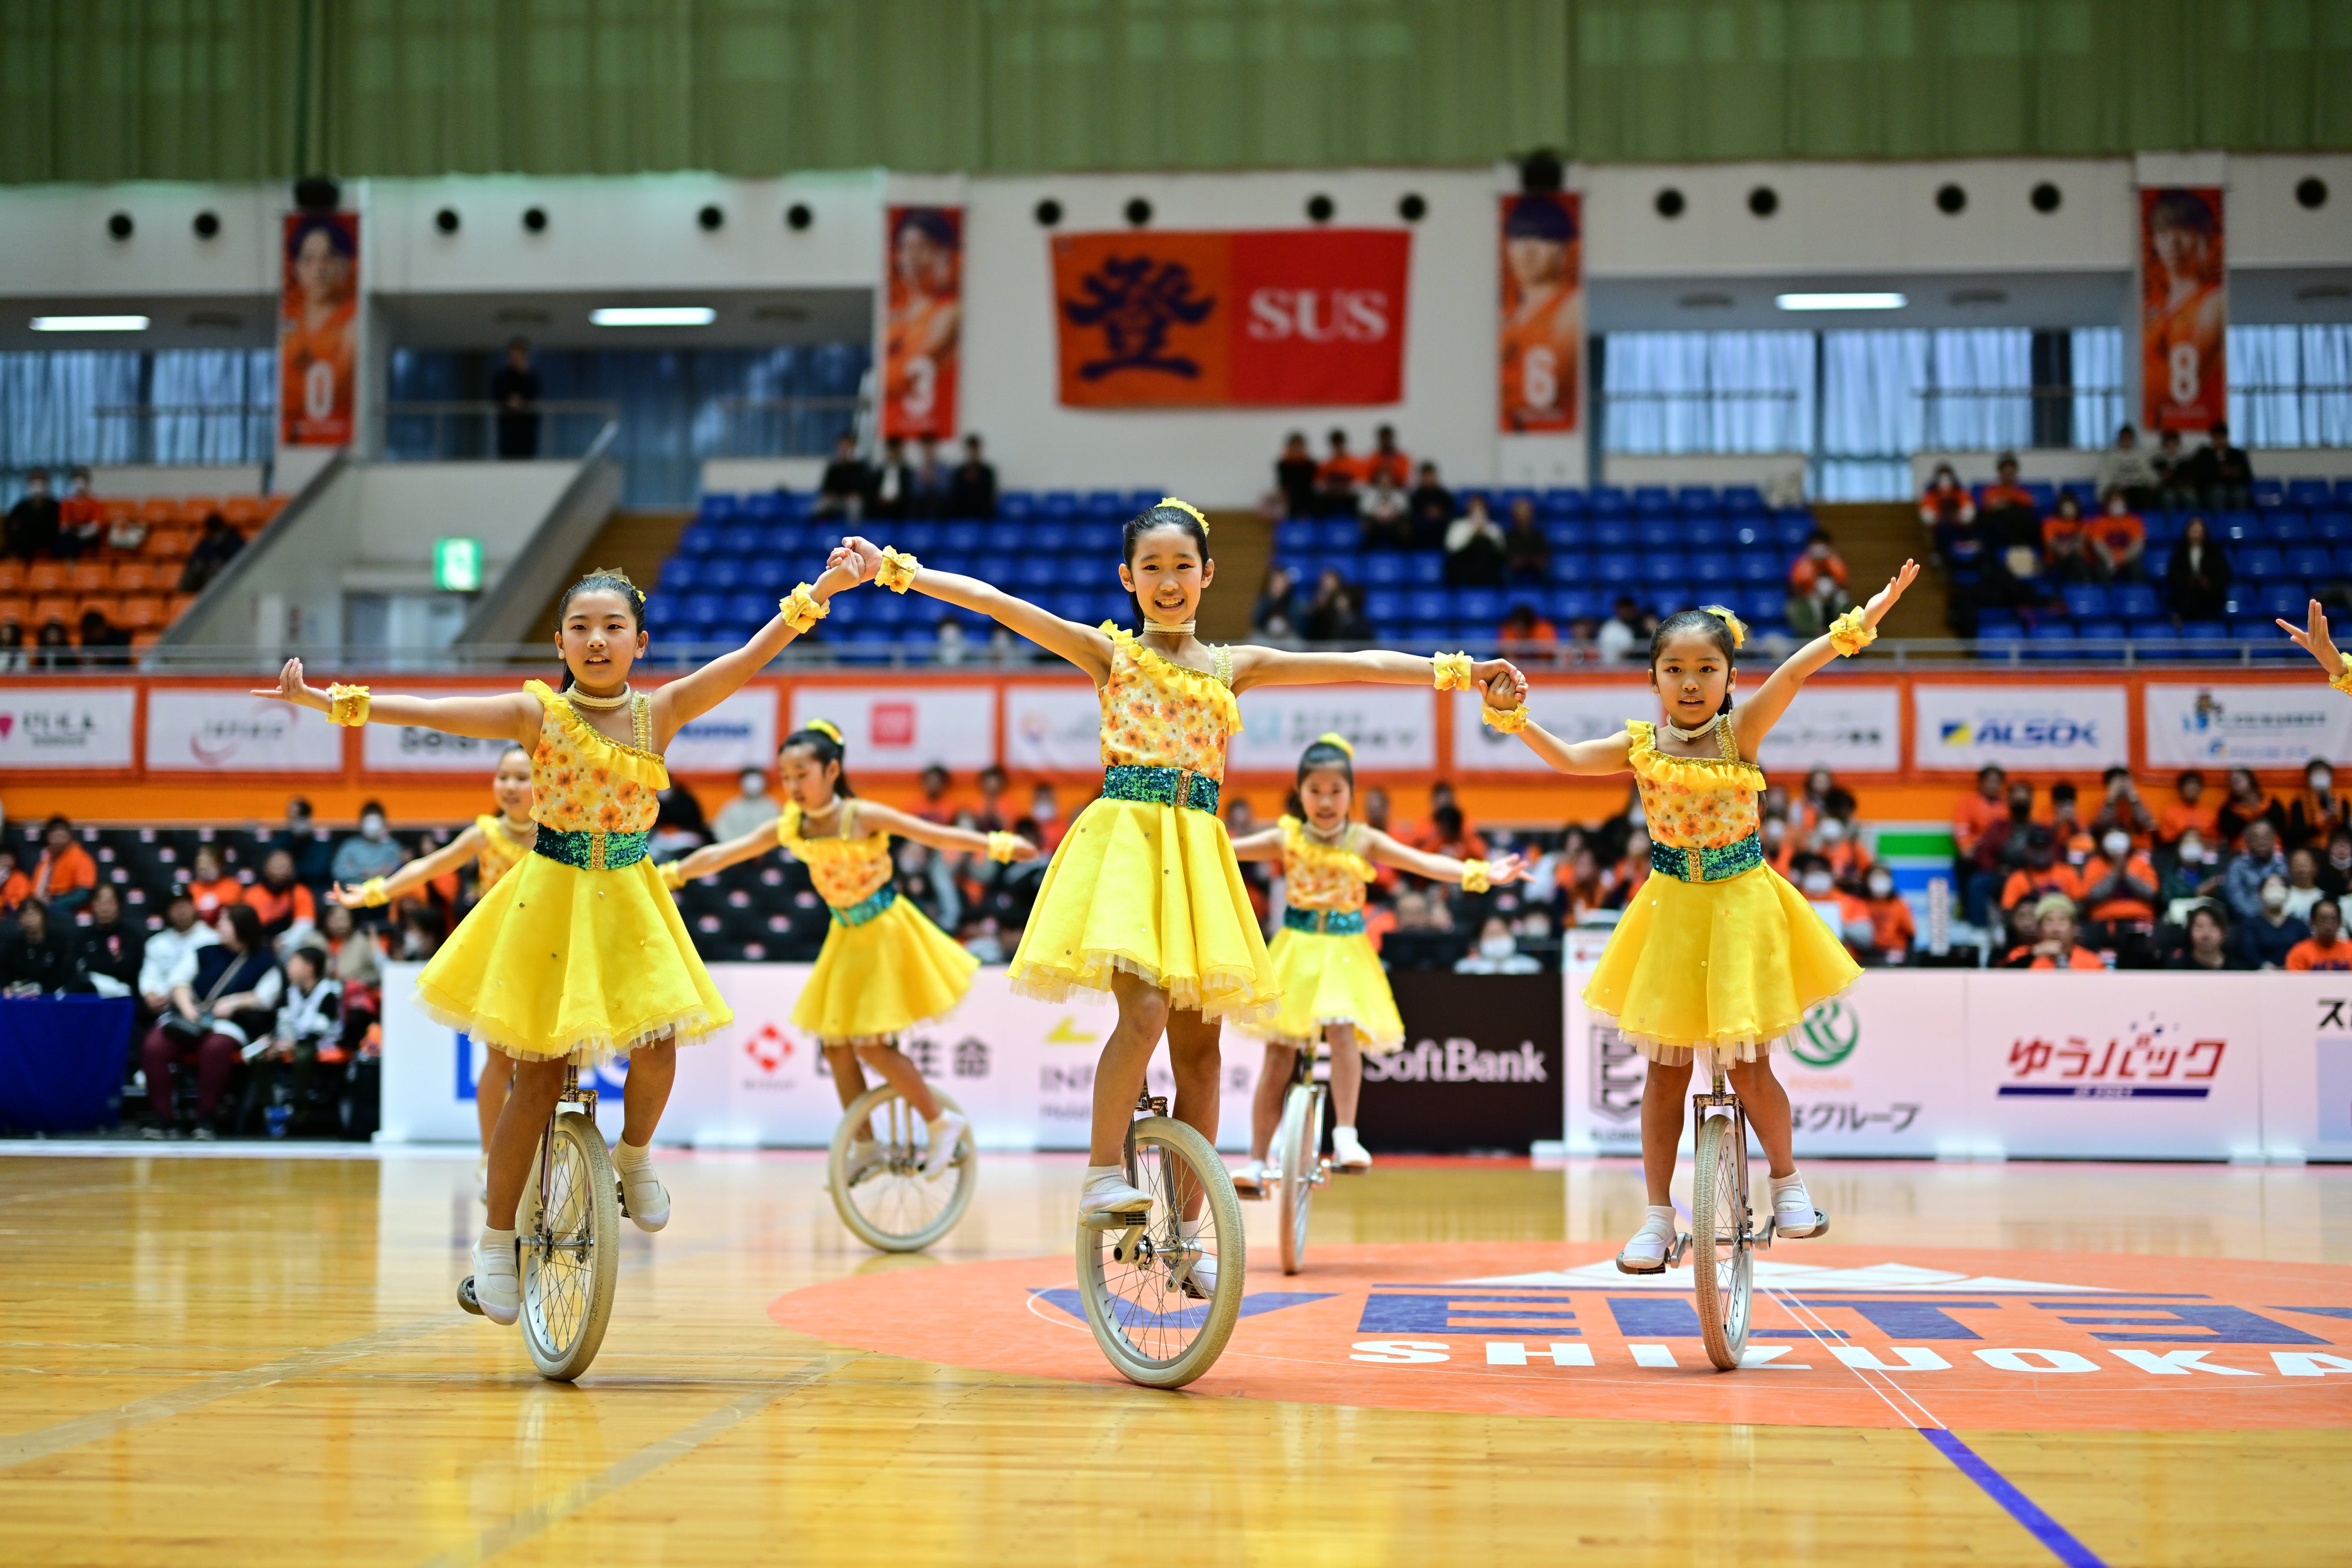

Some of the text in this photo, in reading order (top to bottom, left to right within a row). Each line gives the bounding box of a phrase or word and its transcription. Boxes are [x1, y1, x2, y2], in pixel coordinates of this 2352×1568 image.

[1248, 286, 1389, 342] SUS
[305, 359, 334, 420] 0
[902, 355, 936, 417] 3
[1523, 345, 1557, 407] 6
[2169, 342, 2200, 403] 8
[1974, 717, 2099, 749] ALSOK
[2317, 998, 2352, 1028] ス
[817, 1030, 990, 1077] 生命
[1362, 1038, 1548, 1083] SoftBank
[2007, 1035, 2227, 1079] ゆうパック
[1025, 1287, 2352, 1345] VELTE
[1349, 1340, 2352, 1377] SHIZUOKA
